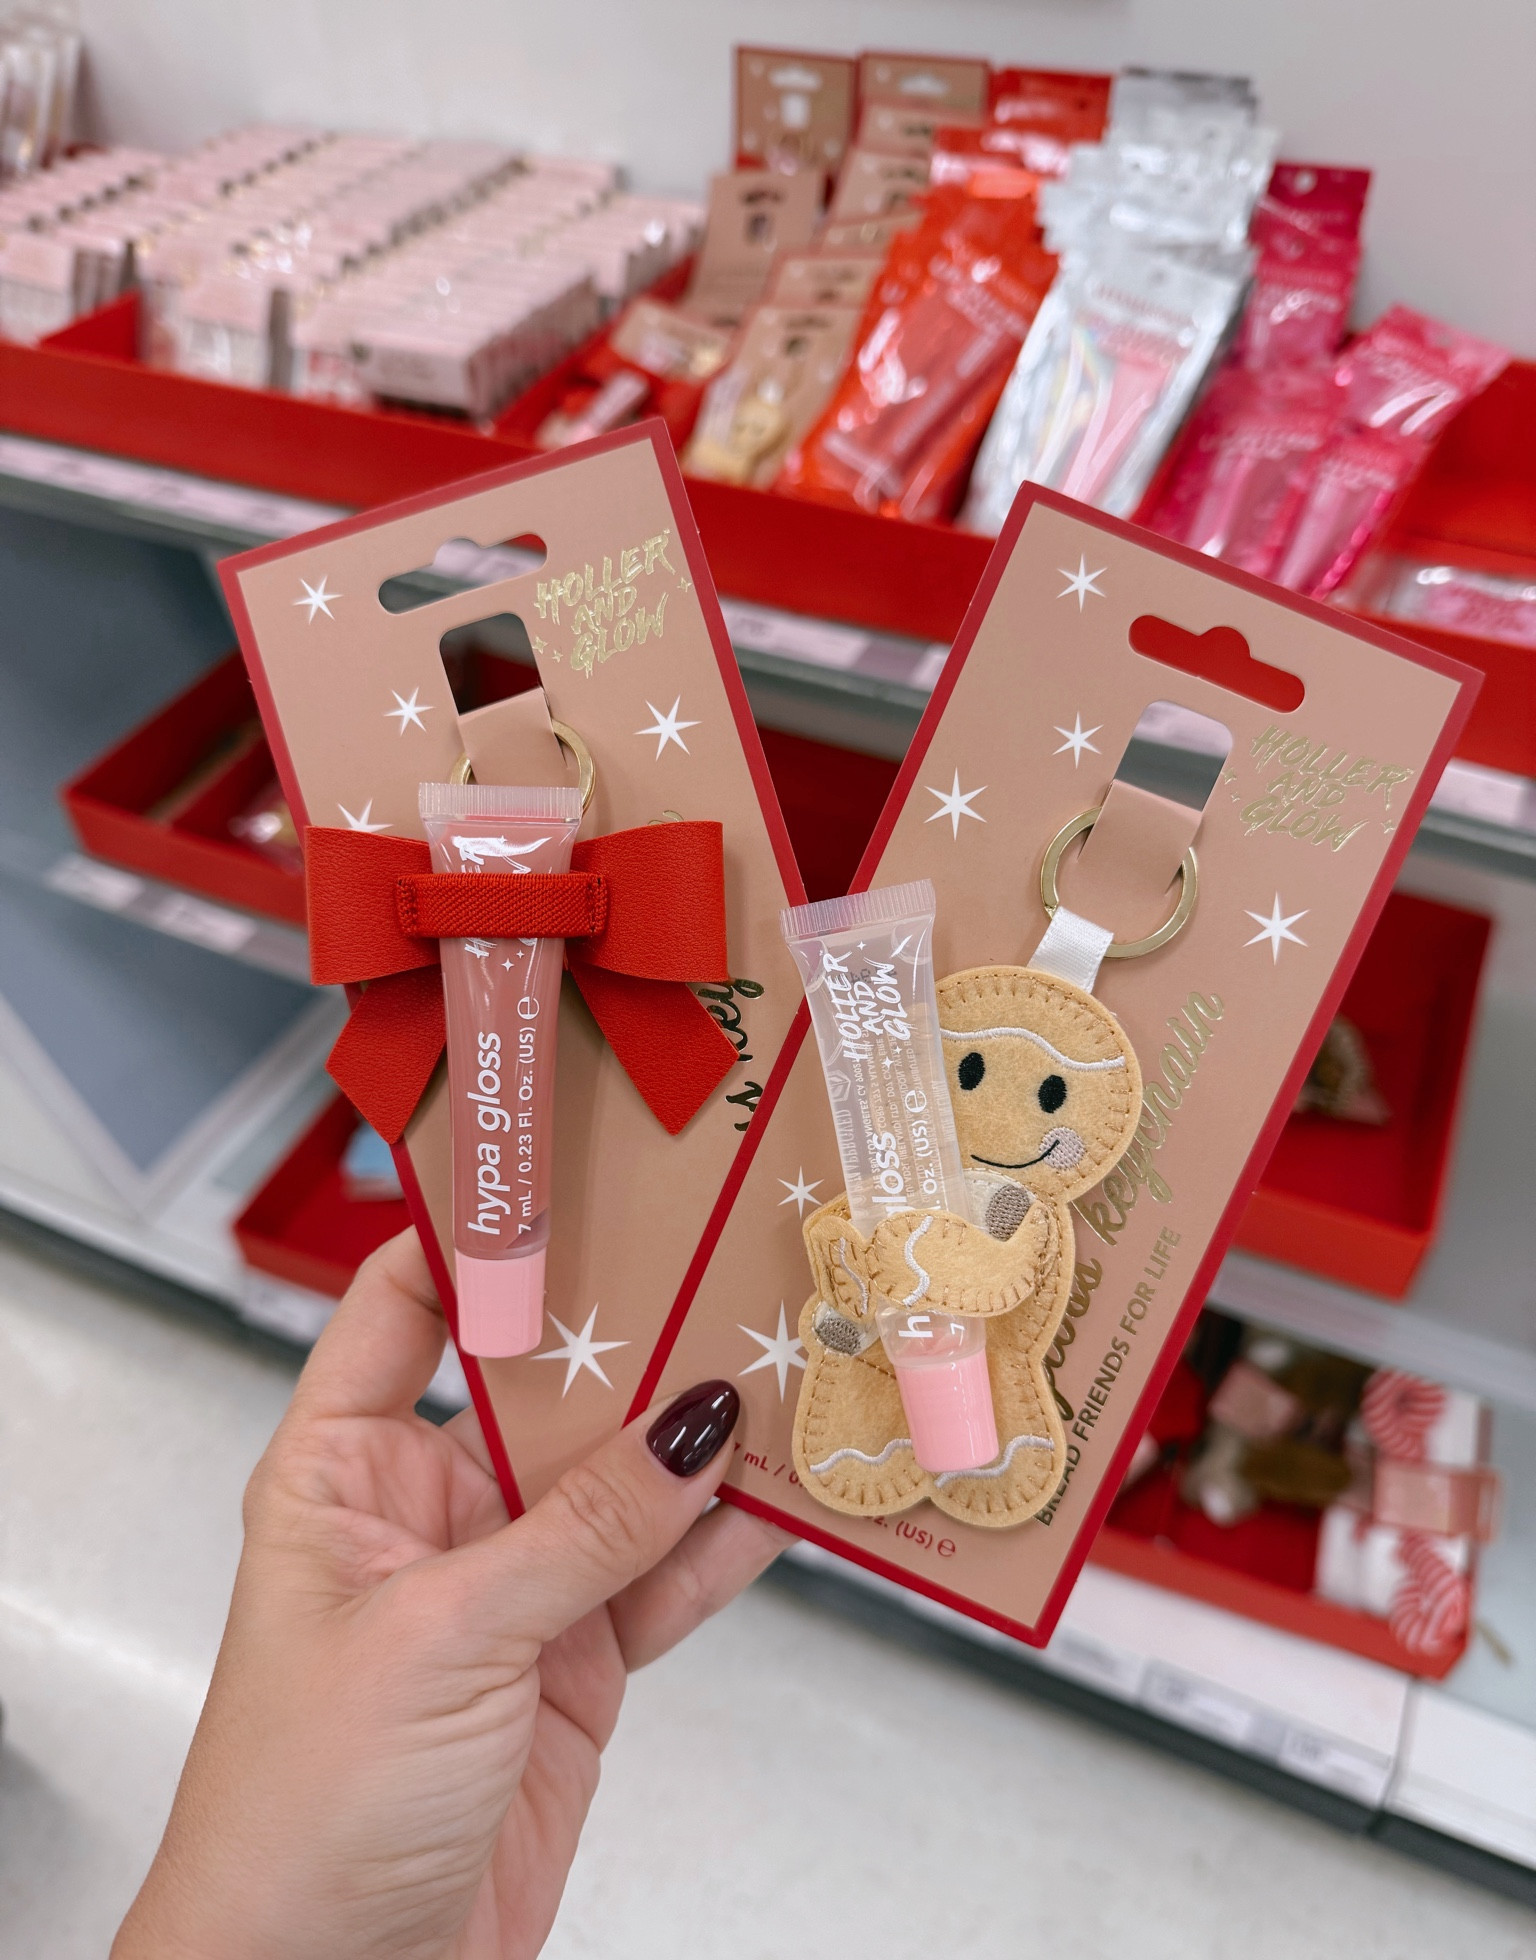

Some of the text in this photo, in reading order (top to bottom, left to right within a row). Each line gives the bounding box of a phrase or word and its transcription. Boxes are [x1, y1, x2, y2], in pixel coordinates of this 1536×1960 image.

[534, 534, 676, 626] HOLLER
[570, 592, 669, 679] GLOW
[571, 586, 637, 635] AND
[1250, 725, 1413, 811] HOLLER
[1267, 771, 1346, 809] AND
[1240, 796, 1370, 852] GLOW
[823, 952, 874, 1060] HOLLER
[854, 981, 886, 1036] AND
[864, 956, 914, 1041] GLOW
[519, 1027, 536, 1064] (US)
[518, 1070, 533, 1101] Oz.
[467, 1032, 511, 1235] hypa gloss
[518, 1107, 533, 1128] Fl.
[912, 1120, 933, 1157] (US)
[518, 1134, 532, 1173] 0.23
[922, 1163, 938, 1195] Oz.
[518, 1190, 532, 1216] mL
[518, 1223, 532, 1234] 7
[1072, 1336, 1130, 1442] FRIENDS
[1120, 1281, 1156, 1336] FOR
[1144, 1226, 1181, 1281] LIFE
[744, 1452, 768, 1471] mL
[896, 1520, 933, 1549] (US)
